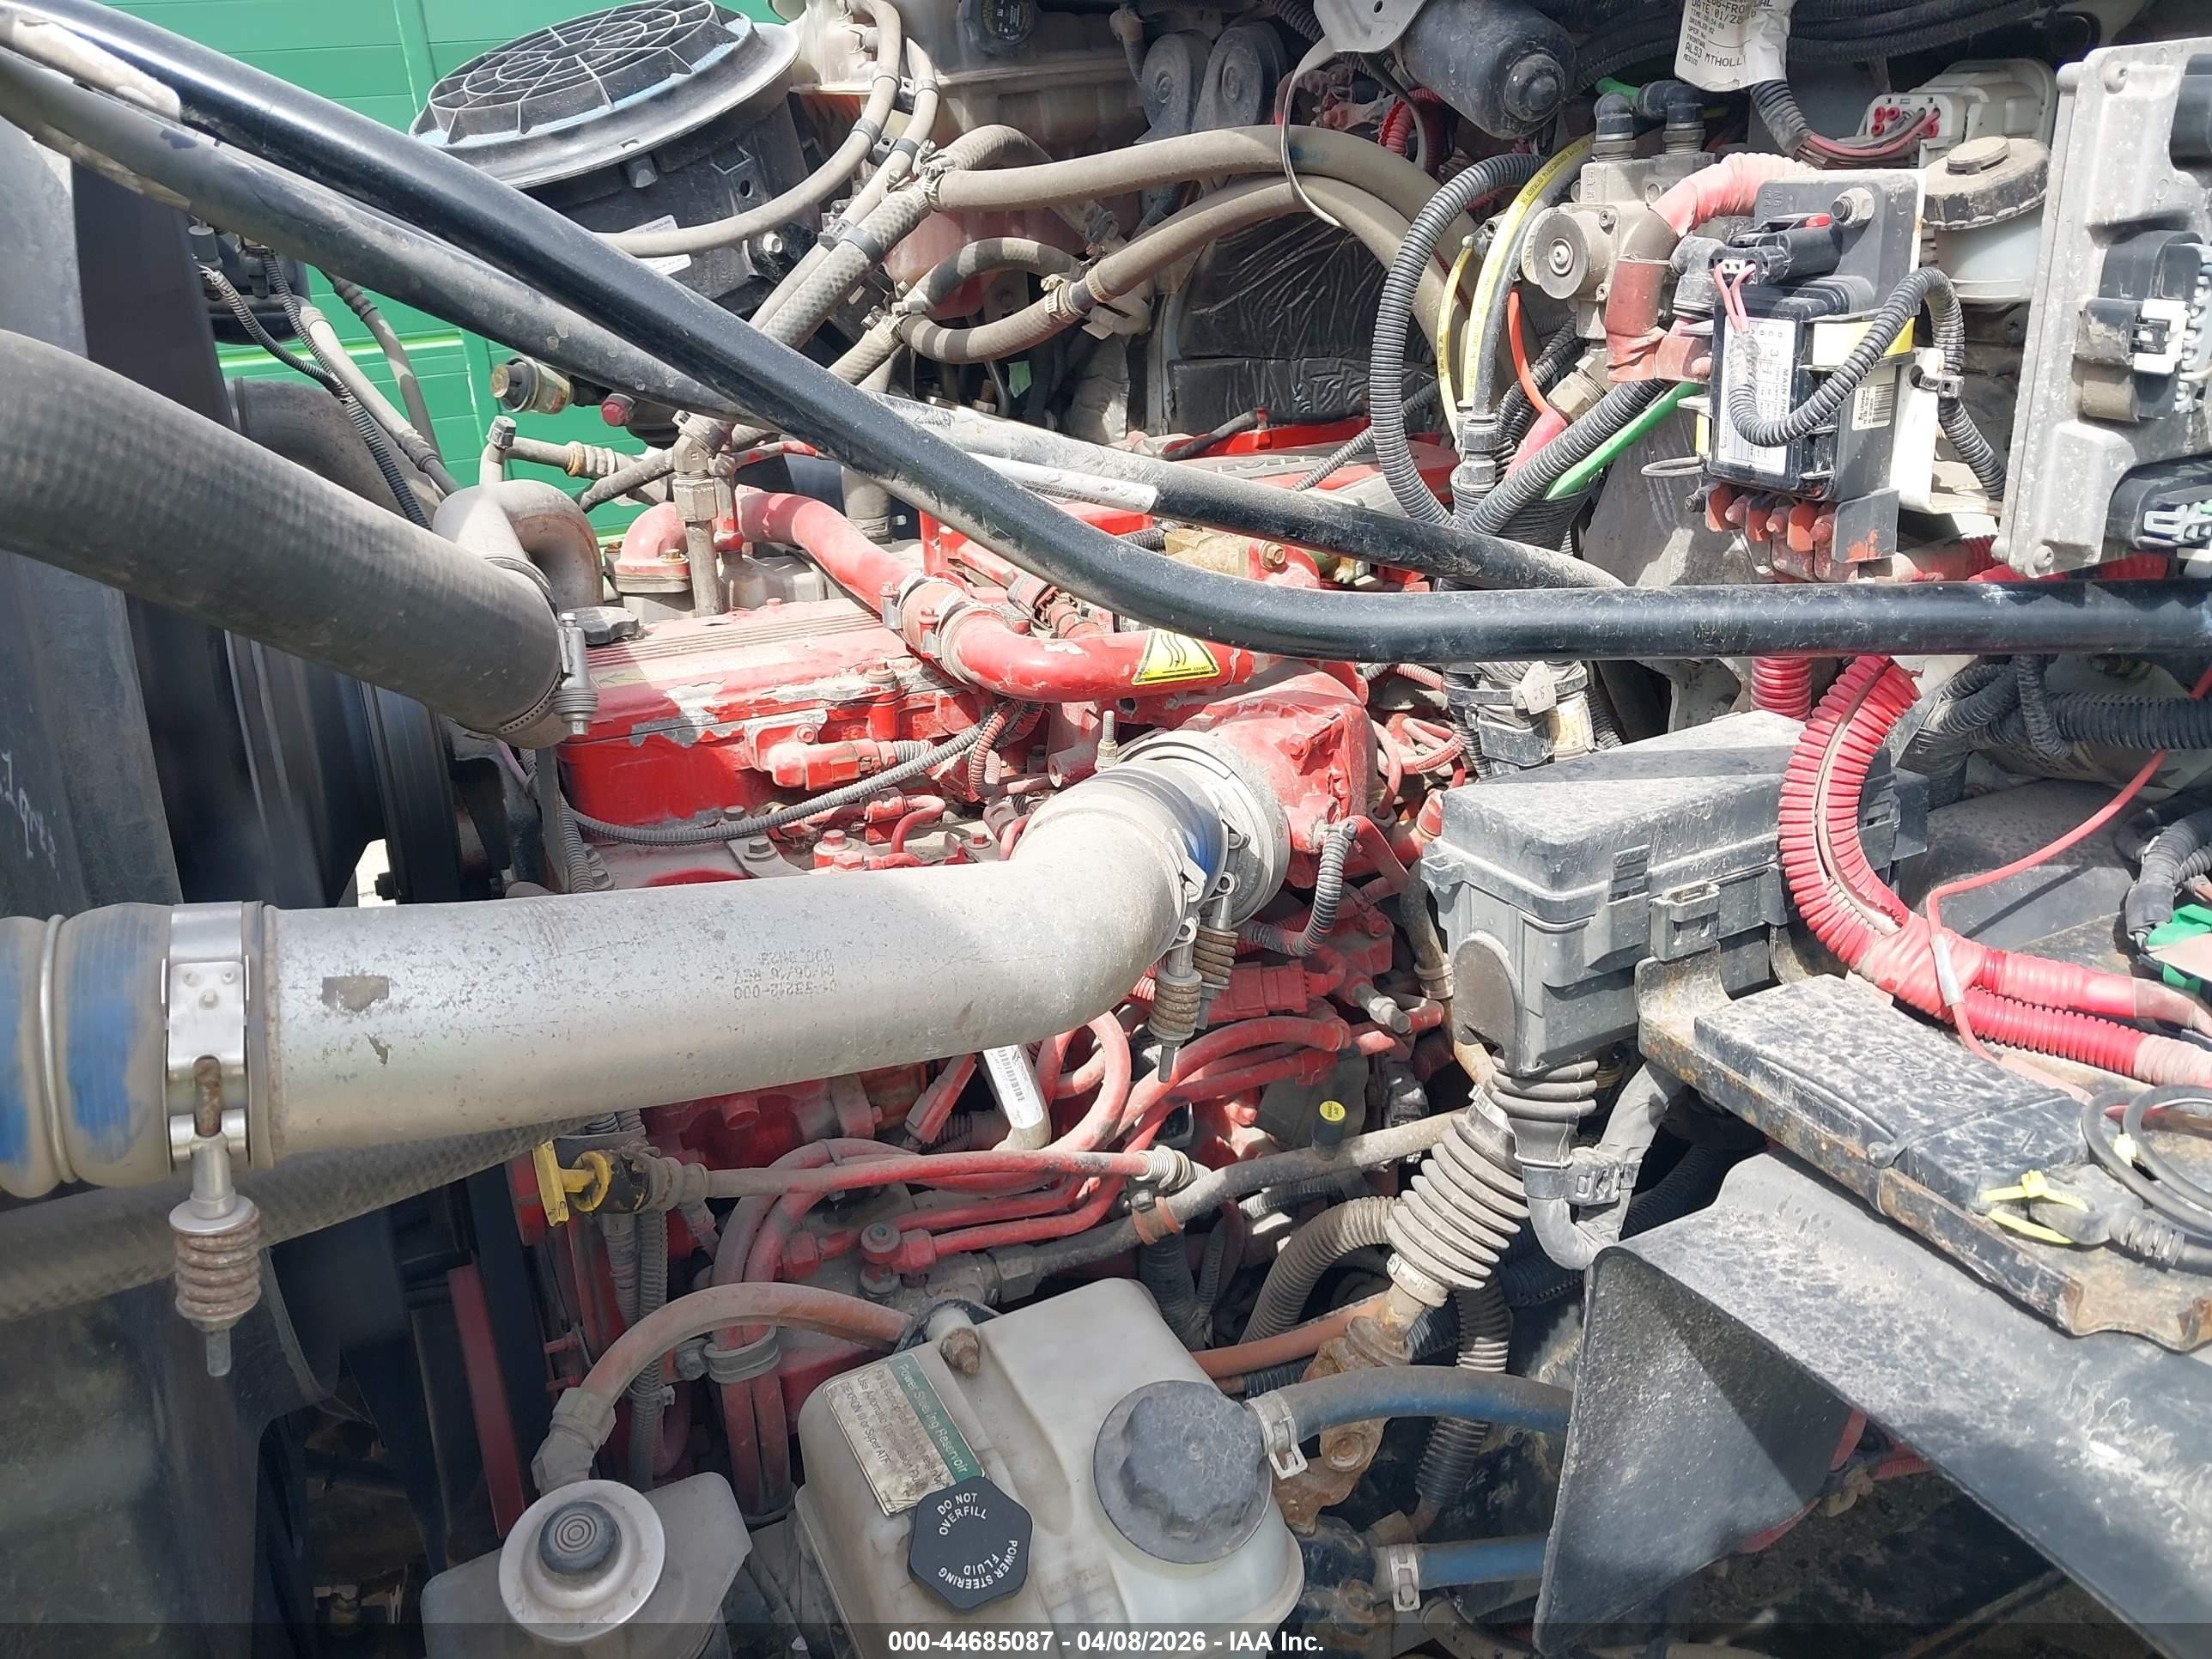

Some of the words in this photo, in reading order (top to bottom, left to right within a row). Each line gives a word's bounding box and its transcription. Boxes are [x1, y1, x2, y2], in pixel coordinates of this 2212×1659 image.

[1685, 42, 1702, 58] AL53
[1705, 52, 1746, 67] MTHOLL
[1780, 368, 1790, 398] MAIN
[857, 1376, 868, 1389] Use
[864, 1389, 888, 1424] Automatic
[840, 1382, 862, 1412] DEXRON
[863, 1428, 881, 1449] Super
[876, 1448, 890, 1465] ATF
[898, 1364, 917, 1389] Power
[912, 1390, 940, 1429] Steering
[935, 1427, 969, 1474] Reservoir
[937, 1500, 952, 1516] DO
[955, 1492, 978, 1504] NOT
[939, 1505, 987, 1535] OVERFILL
[963, 1553, 1000, 1576] FLUID
[994, 1540, 1018, 1578] POWER
[938, 1567, 994, 1589] STEERING
